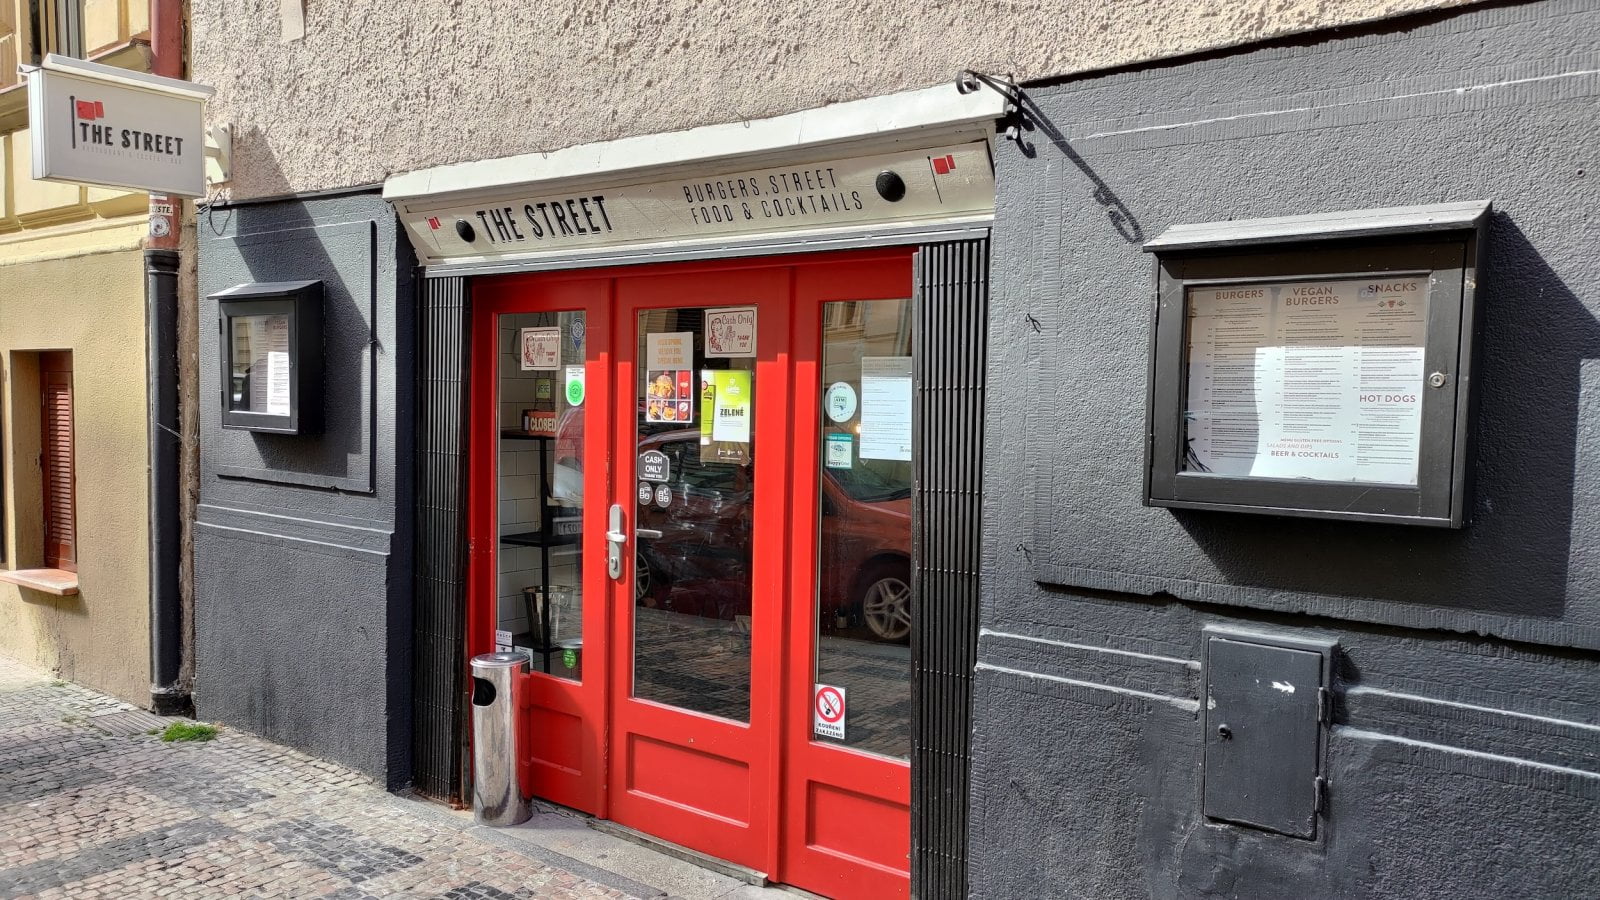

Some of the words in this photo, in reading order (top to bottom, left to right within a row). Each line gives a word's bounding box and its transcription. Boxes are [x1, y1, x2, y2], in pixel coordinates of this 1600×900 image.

[80, 122, 113, 146] THE
[121, 129, 183, 156] STREET
[691, 204, 733, 225] FOOD
[743, 202, 753, 220] &
[762, 191, 863, 218] COCKTAILS
[477, 206, 524, 244] THE
[524, 195, 613, 240] STREET
[1292, 286, 1333, 297] VEGAN
[1368, 282, 1417, 293] SNACKS
[1215, 289, 1264, 300] BURGERS
[1286, 296, 1339, 306] BURGERS
[1359, 394, 1383, 403] HOT
[1384, 394, 1416, 403] DOGS
[720, 406, 744, 417] ZELENÉ
[530, 417, 557, 432] CLOSED
[645, 455, 663, 464] CASH
[1297, 451, 1339, 459] COCKTAILS
[645, 464, 662, 473] ONLY
